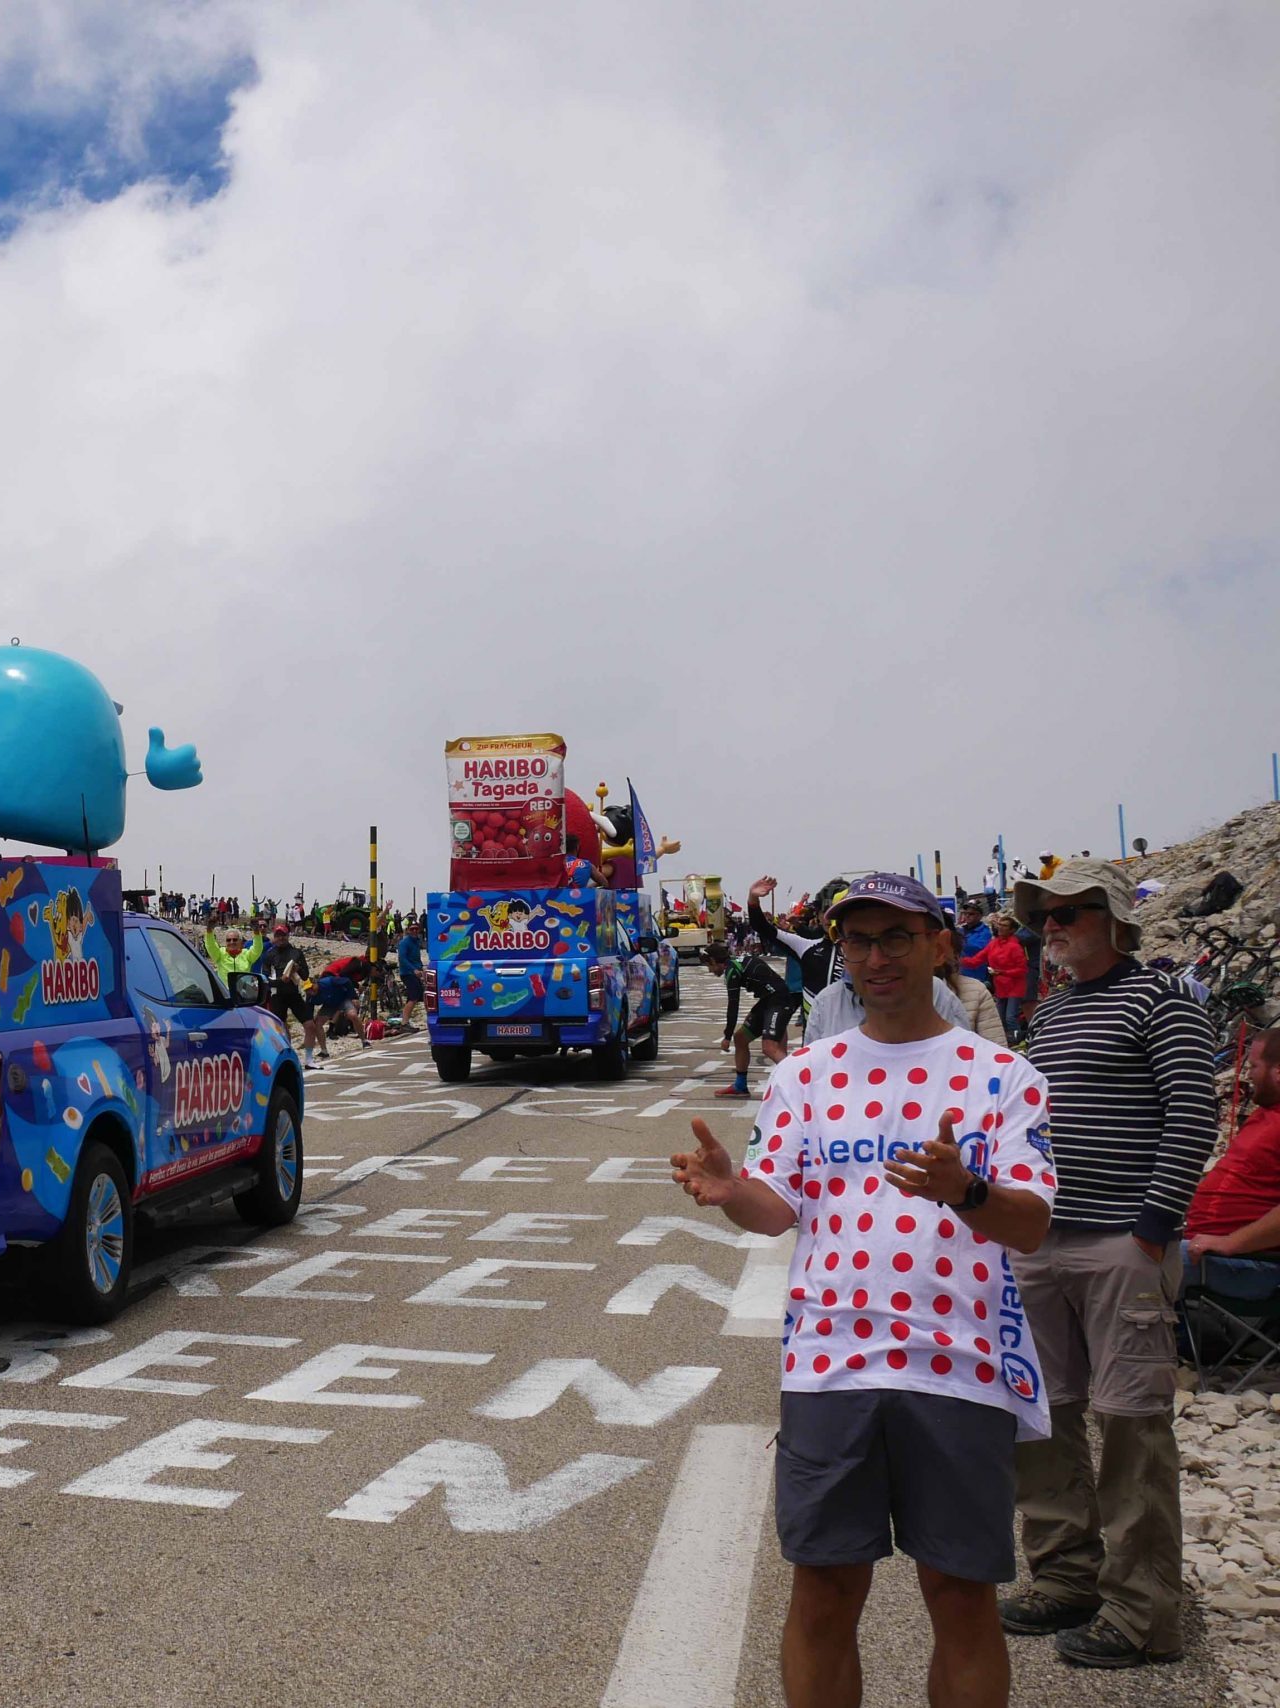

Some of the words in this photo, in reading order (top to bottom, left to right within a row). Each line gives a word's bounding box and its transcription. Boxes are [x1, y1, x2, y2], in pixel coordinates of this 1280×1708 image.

[463, 758, 548, 780] HARIBO
[472, 780, 539, 801] Tagada
[529, 800, 553, 812] RED
[474, 929, 550, 951] HARIBO
[42, 957, 100, 1005] HARIBO
[497, 1025, 532, 1036] HARIBO
[174, 1050, 245, 1129] HARIBO
